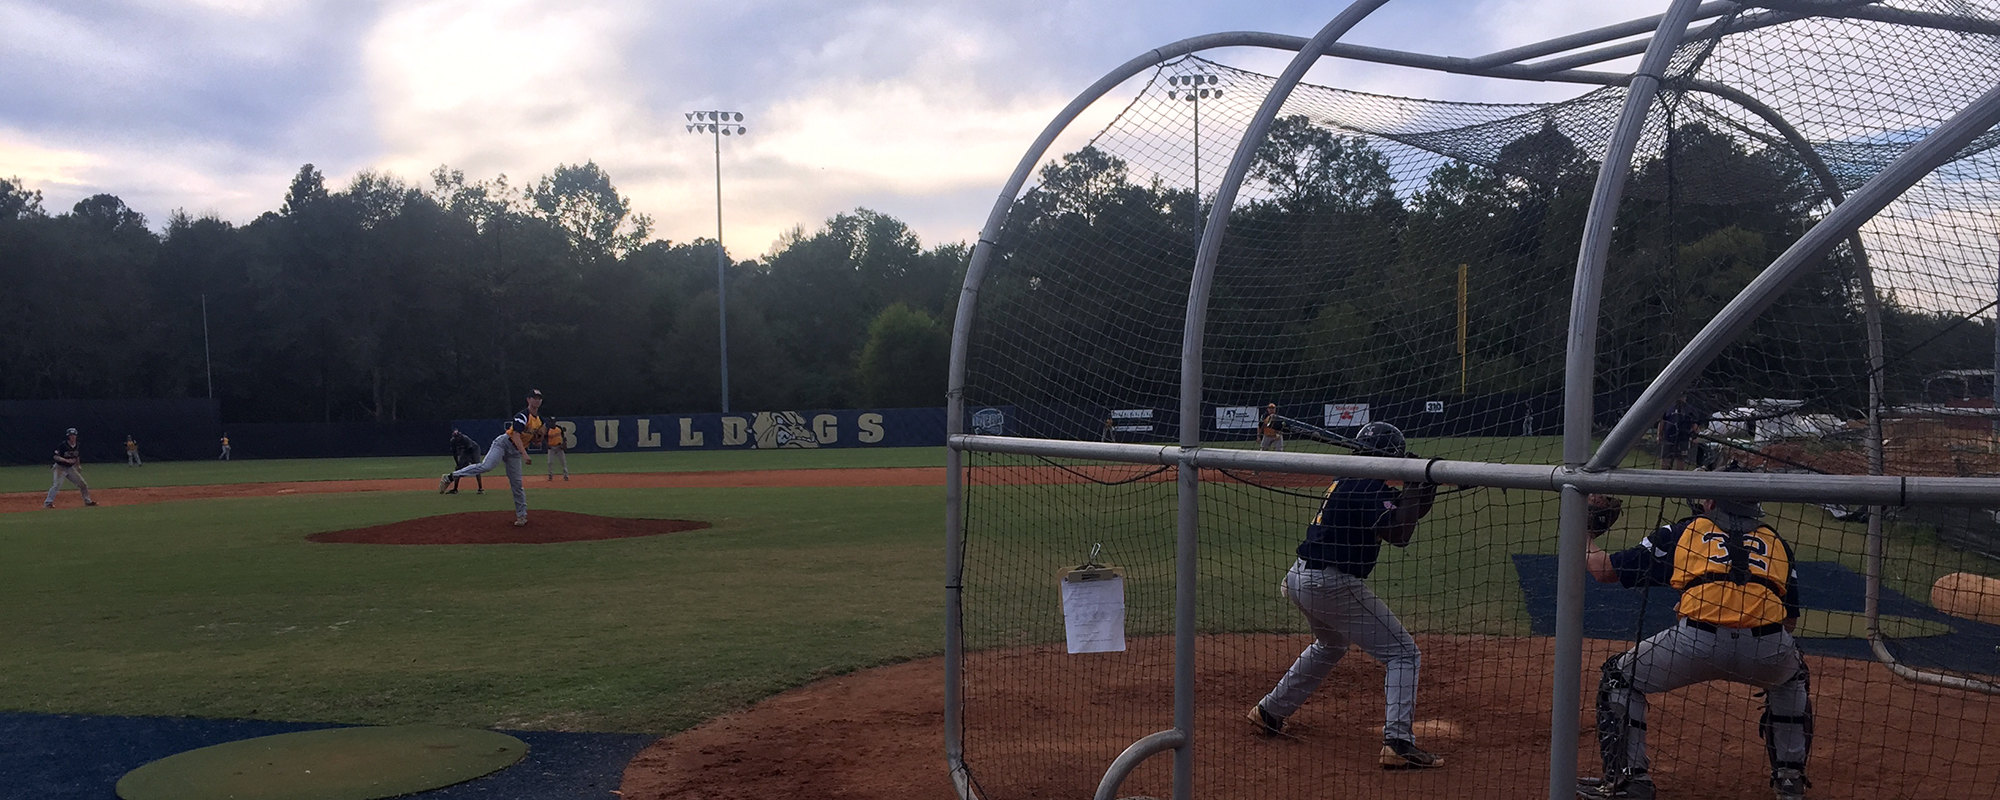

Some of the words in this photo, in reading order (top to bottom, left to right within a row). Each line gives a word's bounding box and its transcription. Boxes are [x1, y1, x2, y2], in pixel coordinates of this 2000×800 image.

[1427, 402, 1442, 411] 310
[555, 412, 885, 449] BULLDGS
[1701, 532, 1768, 572] 32
